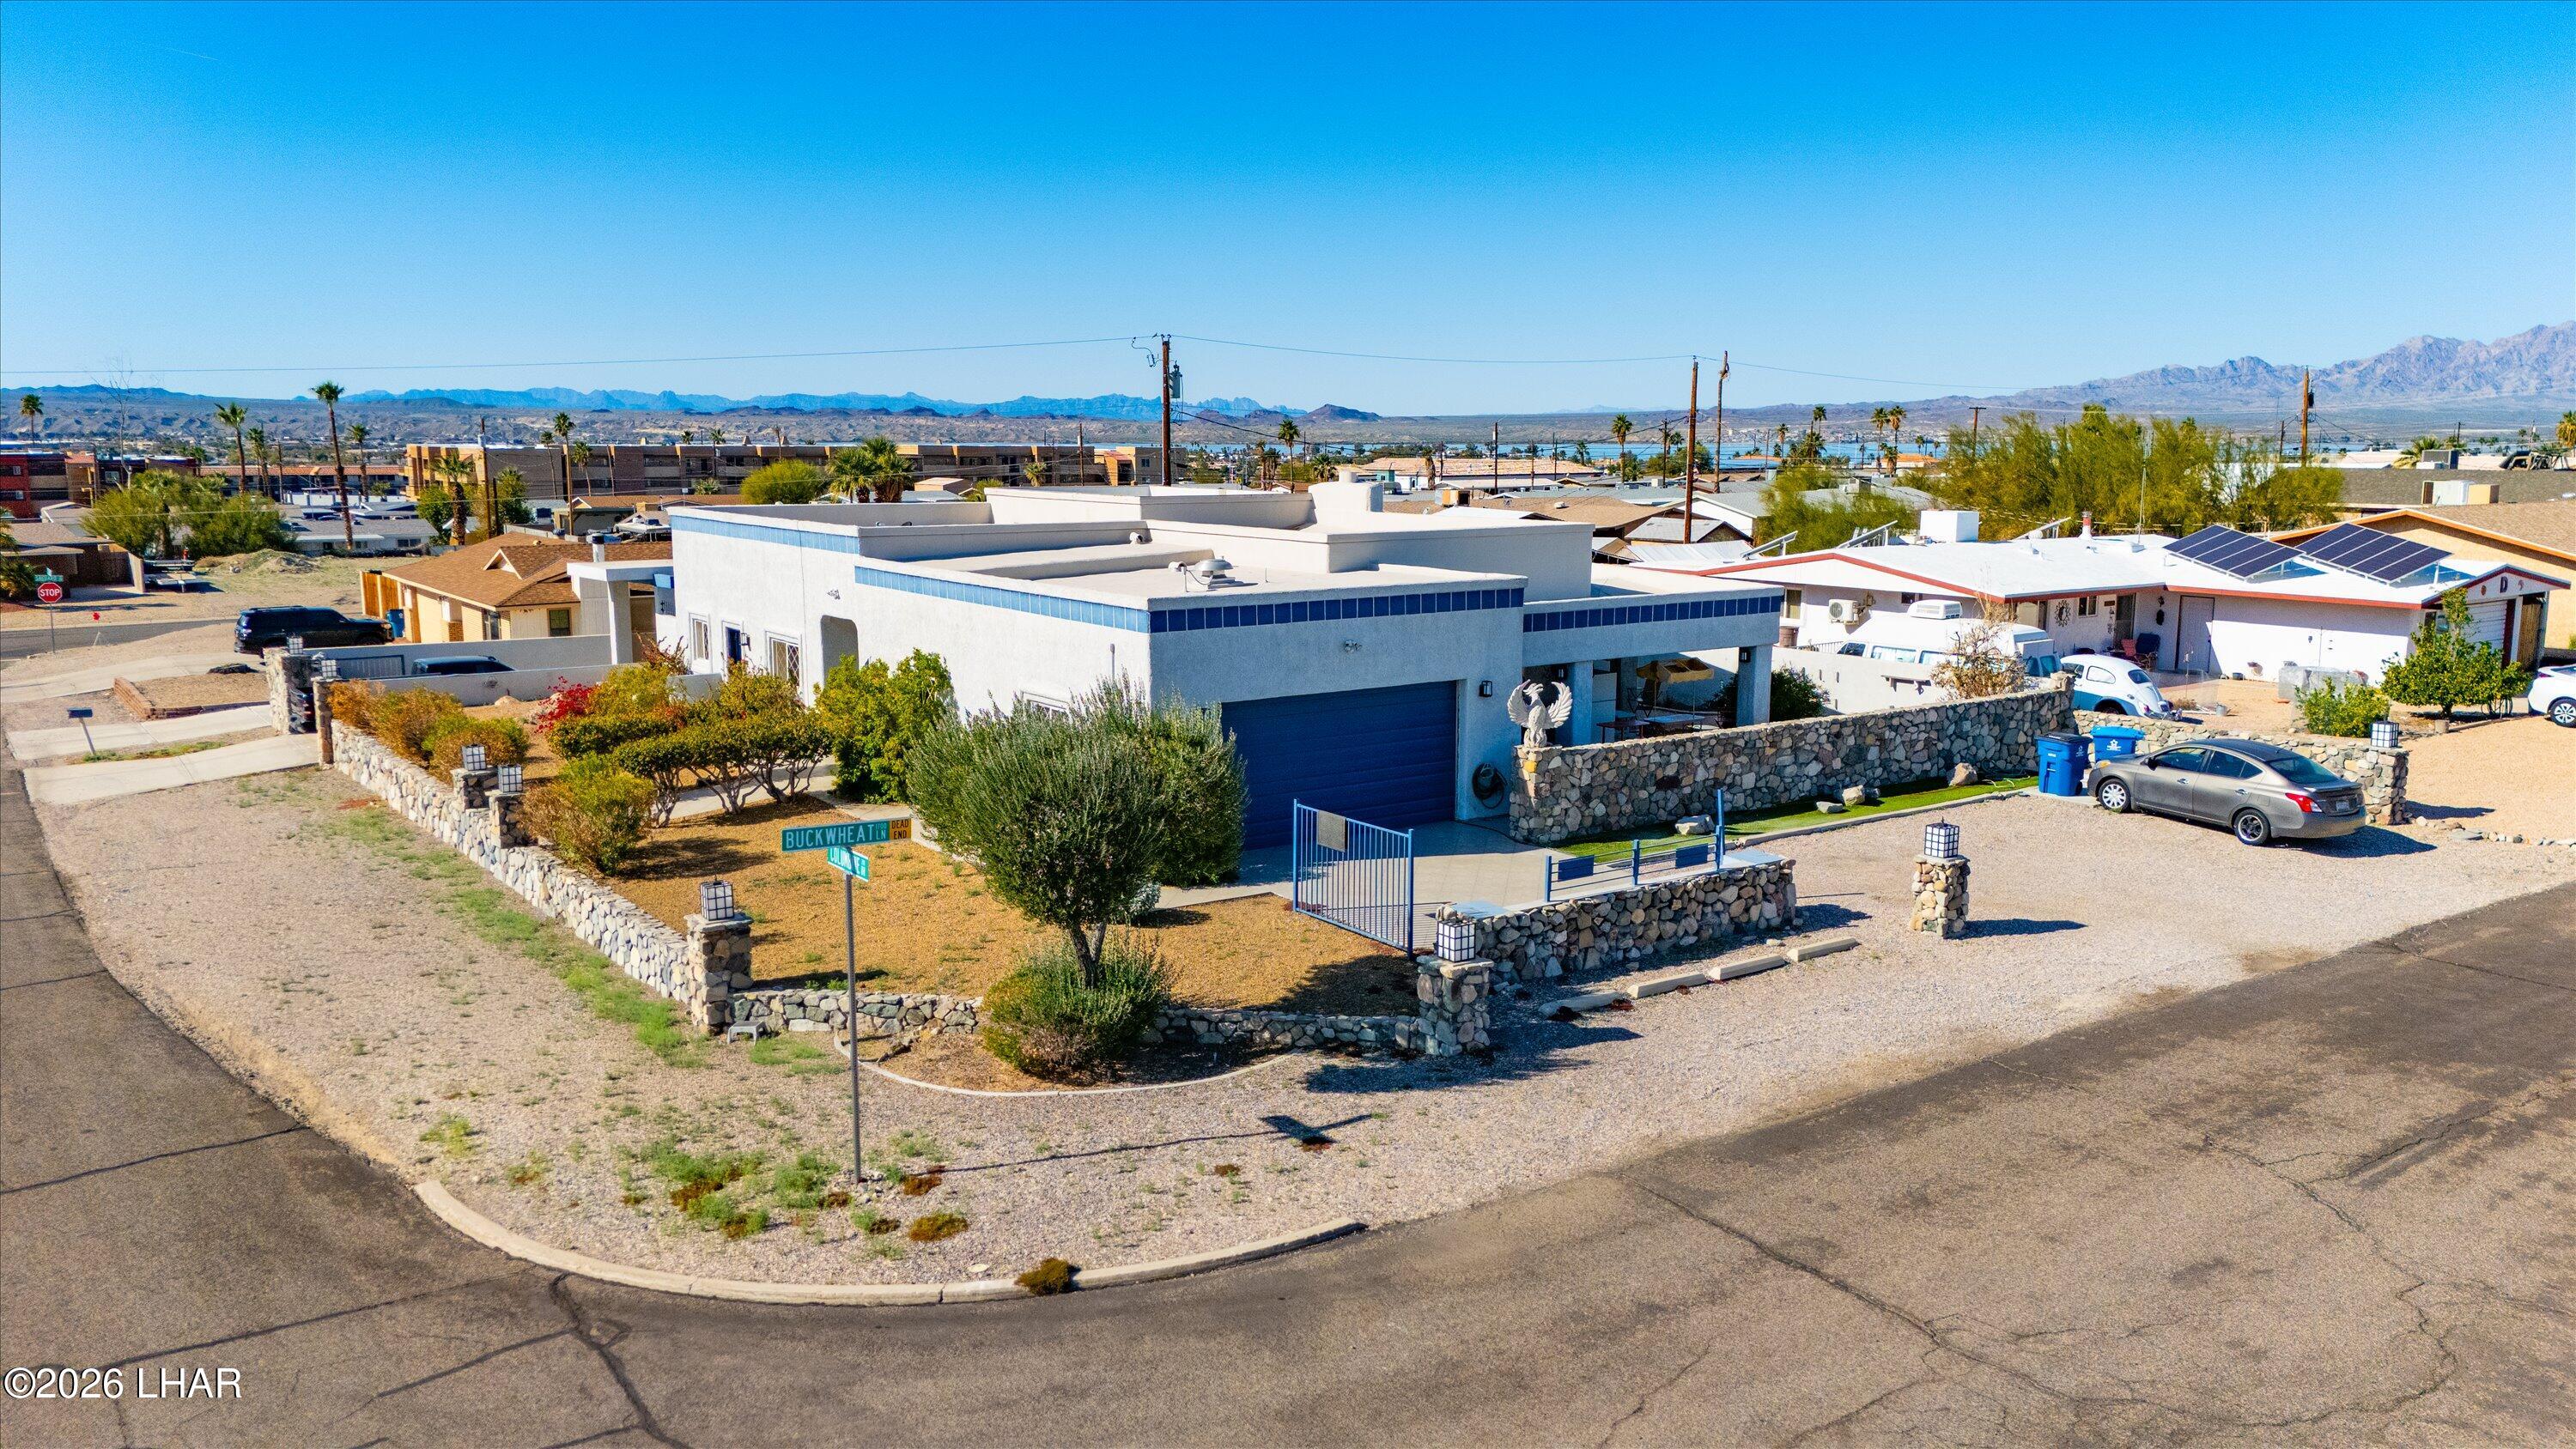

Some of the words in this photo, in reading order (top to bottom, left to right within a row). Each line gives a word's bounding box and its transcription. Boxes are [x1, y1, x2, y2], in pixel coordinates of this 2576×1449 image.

[39, 588, 60, 597] STOP
[891, 819, 909, 829] DEAD
[786, 824, 874, 848] BUCKWHEAT
[876, 829, 886, 840] LN
[893, 830, 907, 840] END
